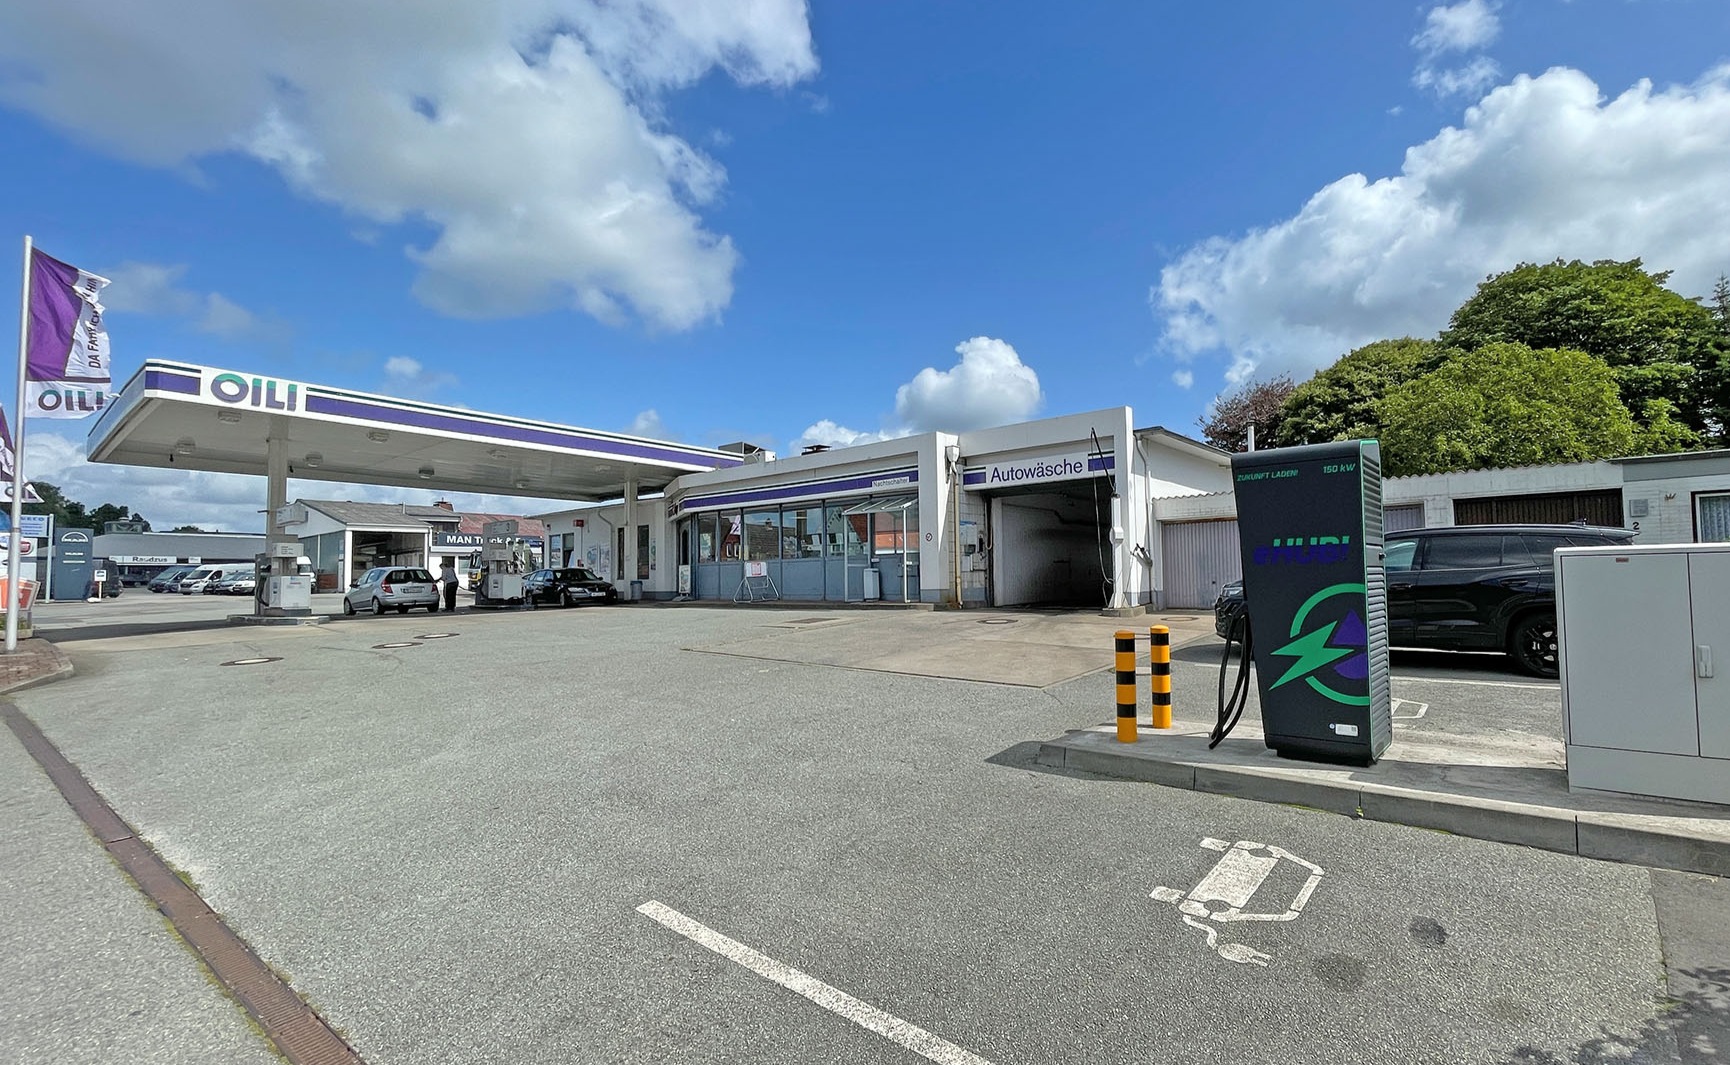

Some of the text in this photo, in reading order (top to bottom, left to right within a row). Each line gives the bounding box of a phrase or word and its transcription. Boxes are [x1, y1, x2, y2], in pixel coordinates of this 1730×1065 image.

[88, 355, 101, 369] DA
[990, 458, 1084, 483] Autowäsche
[1323, 463, 1356, 474] 150 kW
[1236, 469, 1299, 482] ZUKUNFT LADEN!
[872, 478, 909, 488] Nachtschalter
[1632, 521, 1640, 530] 2
[446, 535, 472, 544] MAN
[474, 536, 503, 544] Trck
